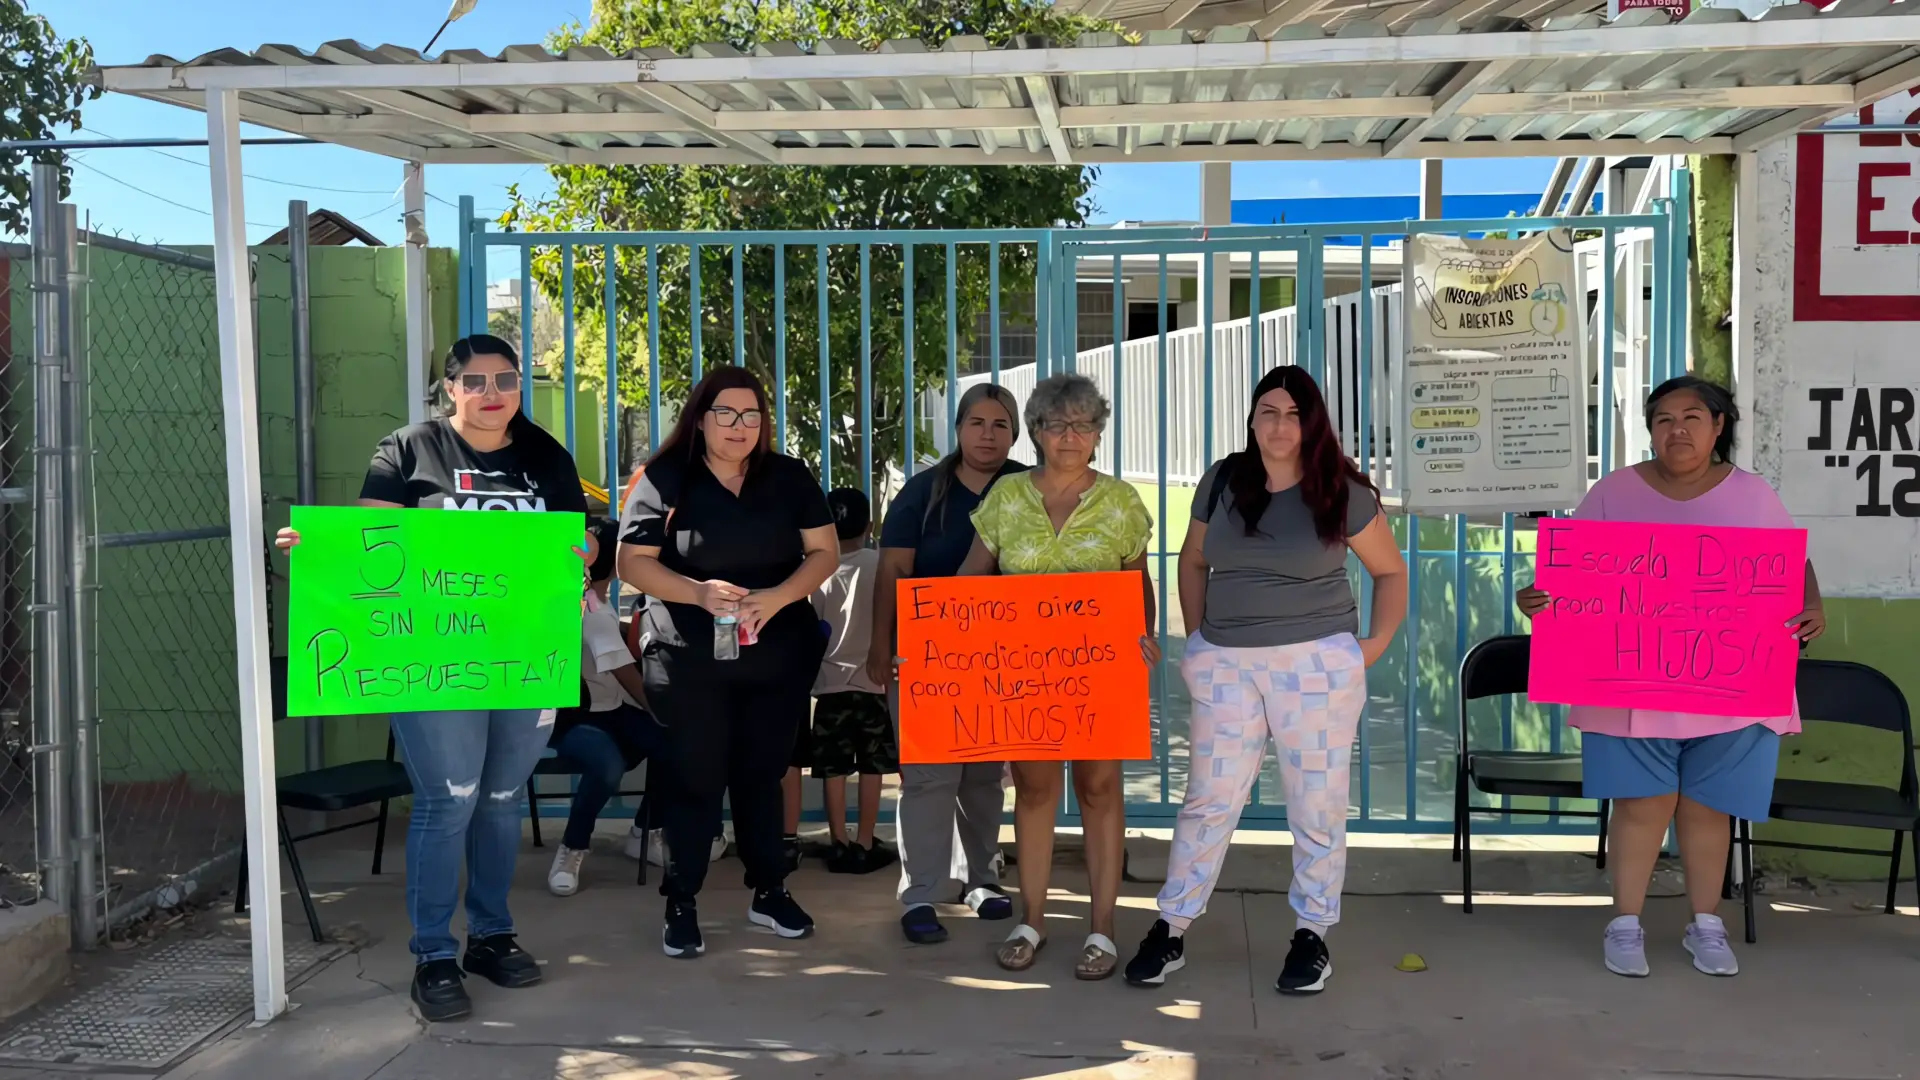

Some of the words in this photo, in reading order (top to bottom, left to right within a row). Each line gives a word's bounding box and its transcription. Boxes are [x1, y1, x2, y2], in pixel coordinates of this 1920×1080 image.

[1857, 162, 1920, 244] E
[1808, 388, 1920, 451] JAR
[359, 525, 406, 591] 5
[422, 568, 508, 598] MESES
[1544, 528, 1669, 580] Escuela
[1696, 534, 1787, 597] Digna
[368, 607, 413, 637] SIN
[435, 611, 487, 636] UNA
[910, 585, 1018, 632] Exigimos
[1619, 580, 1748, 623] Nuestros
[924, 634, 1116, 671] Acondicionados
[984, 671, 1091, 698] Nuestros
